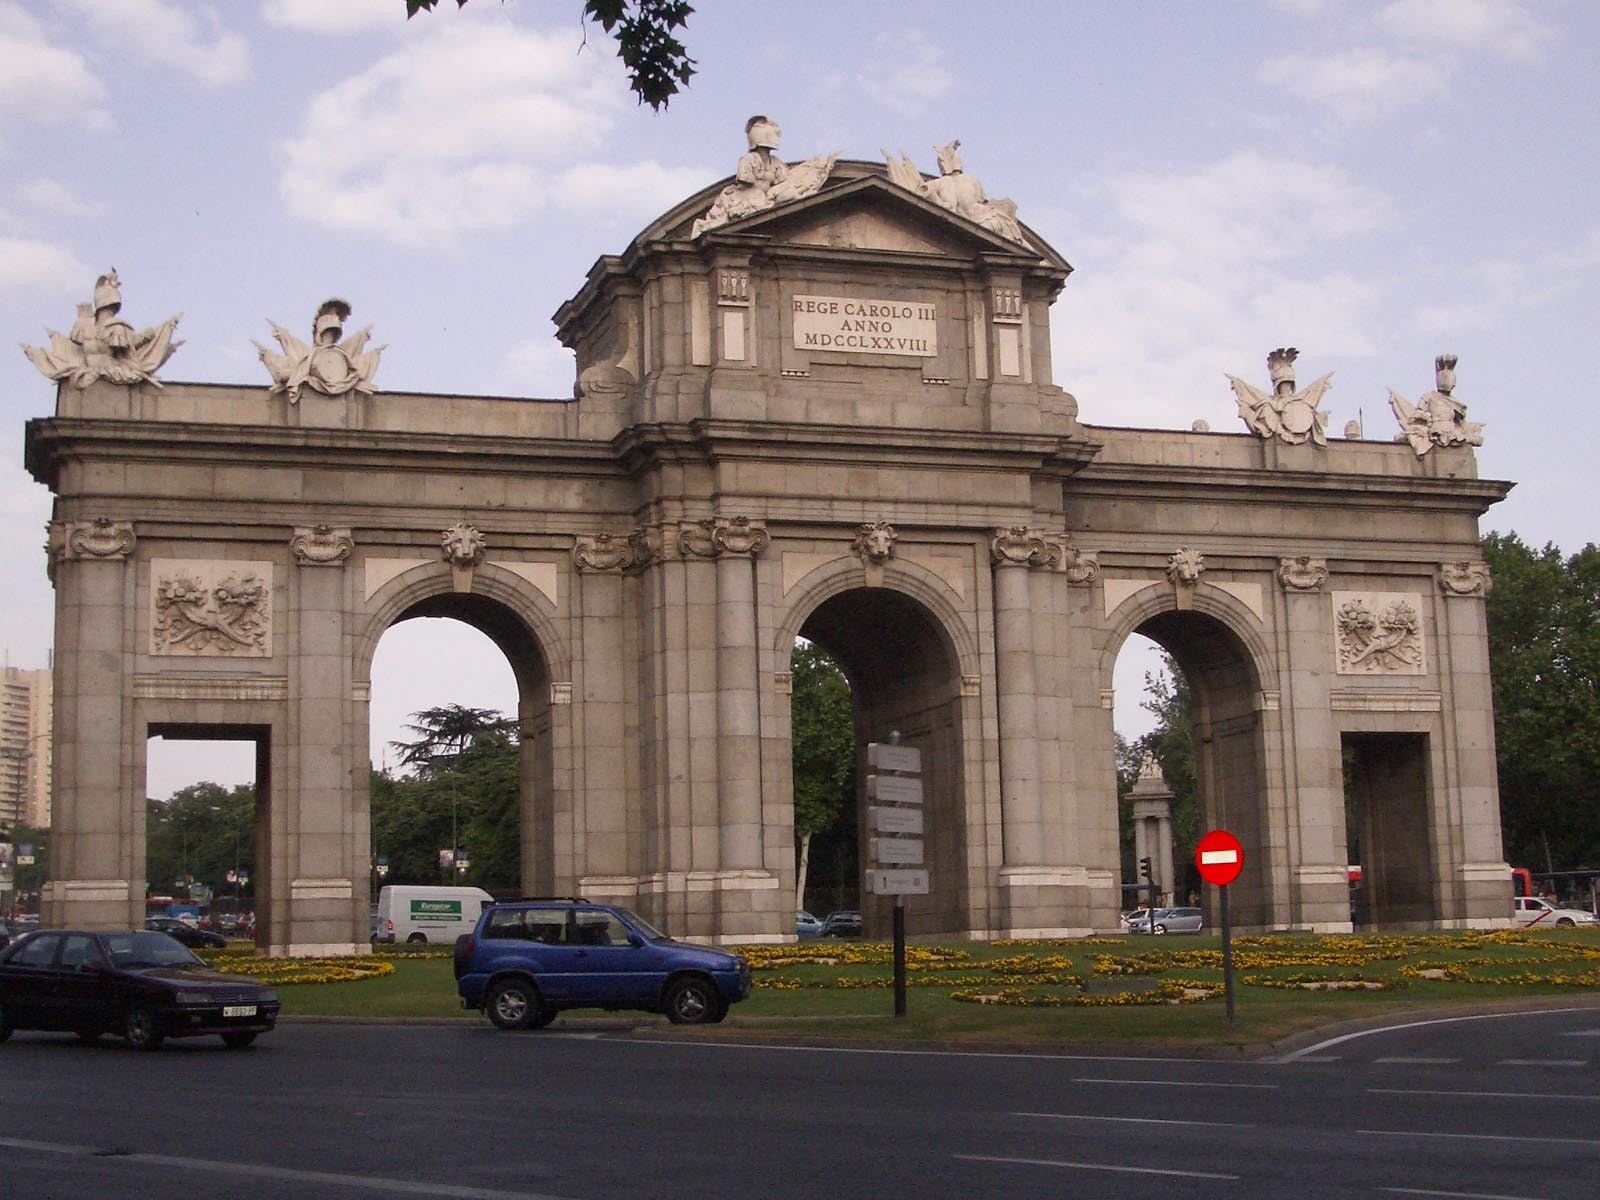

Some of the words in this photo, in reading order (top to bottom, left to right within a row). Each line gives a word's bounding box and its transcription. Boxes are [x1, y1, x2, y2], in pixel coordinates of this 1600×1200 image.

[793, 300, 839, 314] REGE
[844, 303, 913, 318] CAROLO
[918, 307, 936, 321] III
[840, 319, 892, 333] ANNO
[805, 333, 928, 351] MDCCLXXVIII
